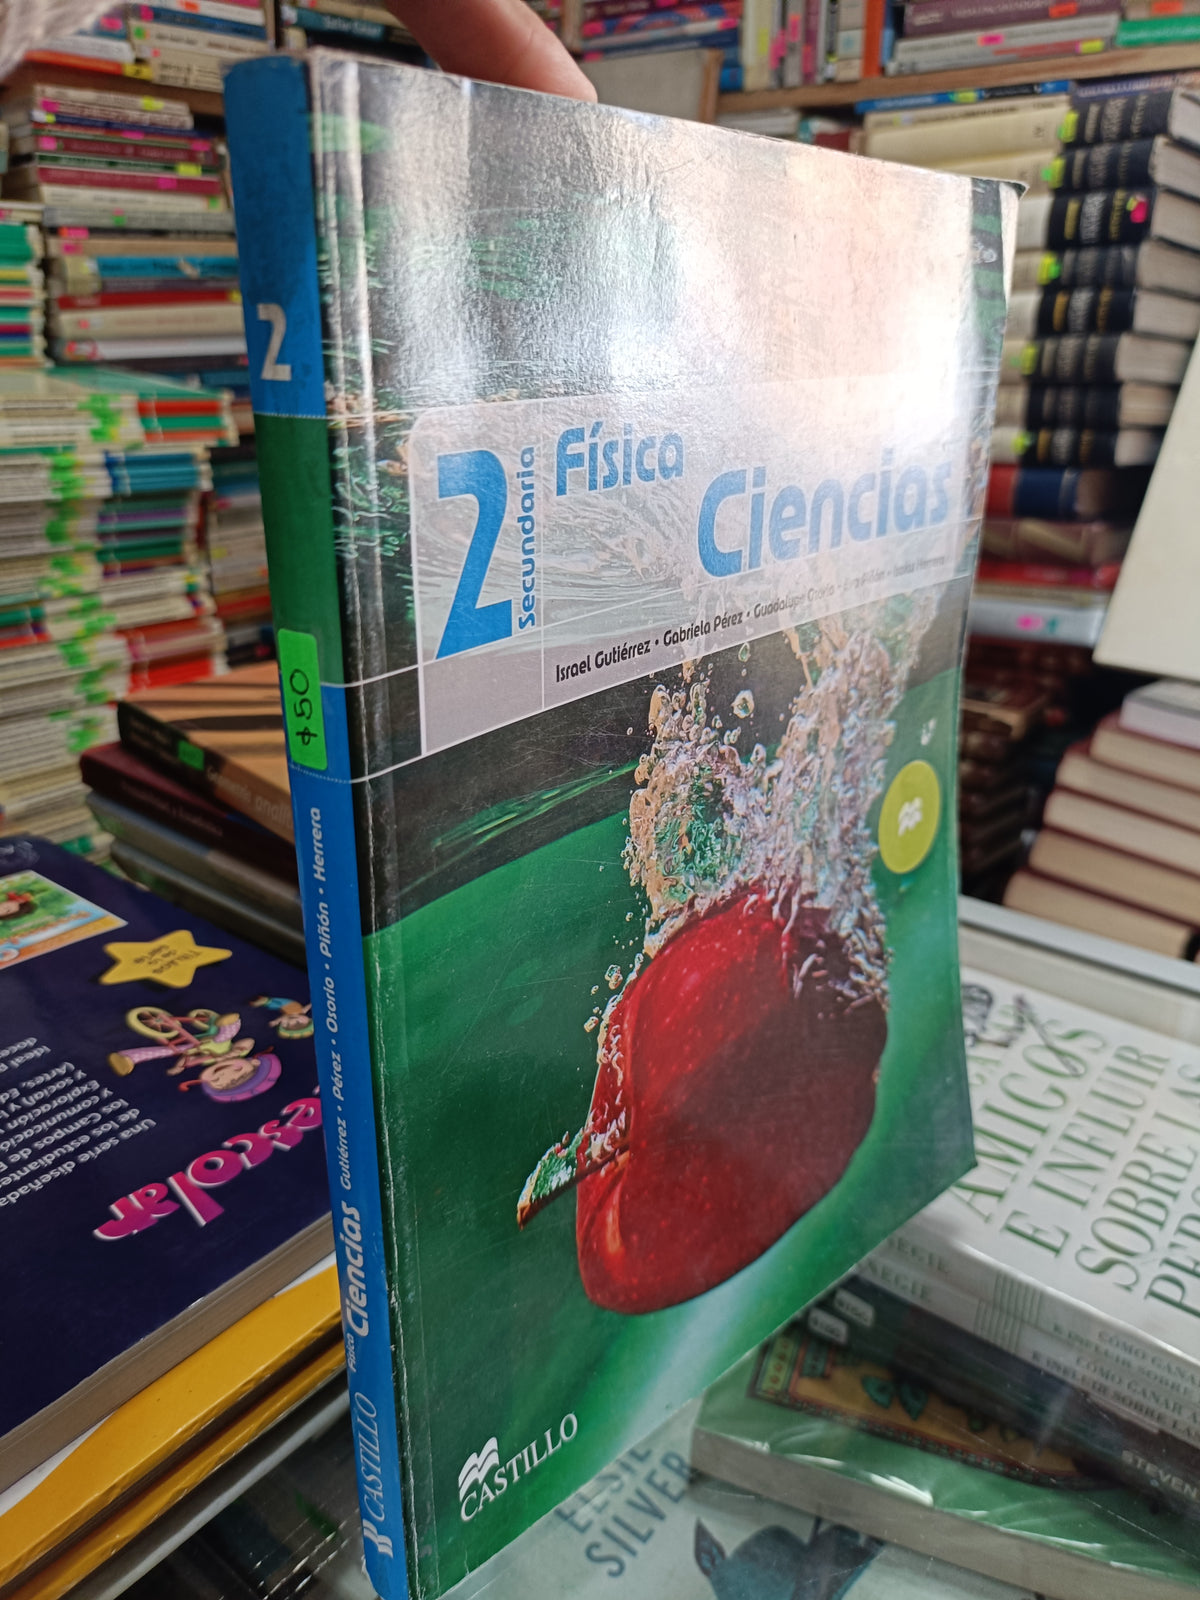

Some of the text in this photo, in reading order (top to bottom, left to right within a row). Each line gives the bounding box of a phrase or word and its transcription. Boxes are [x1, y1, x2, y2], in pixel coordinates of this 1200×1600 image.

[257, 302, 292, 381] 2
[556, 421, 684, 497] Física
[698, 448, 952, 577] Ciencias
[435, 449, 513, 661] 2
[518, 446, 535, 630] Secundaria
[556, 655, 591, 682] Israel
[595, 640, 651, 669] Gutiérrez
[663, 620, 710, 647] Gabriela
[714, 611, 743, 633] Pérez
[310, 807, 351, 1190] Gutiérrez Pérez Osorio Piñón Herrera
[6, 1079, 100, 1130] Exploración
[7, 1098, 129, 1163] los Campos de
[77, 1137, 120, 1163] serie
[90, 1120, 120, 1137] los
[117, 1108, 140, 1123] de
[119, 1118, 157, 1138] Una
[950, 1018, 1108, 1224] AMIGOS
[1000, 1045, 1170, 1258] E INFLUIR
[0, 1134, 91, 1188] estudiante
[1075, 1132, 1199, 1294] SOBRE
[339, 1200, 369, 1338] Ciencias
[354, 1392, 385, 1522] CASTILLO
[460, 1413, 578, 1522] CASTILLO
[585, 1451, 690, 1578] SILVER
